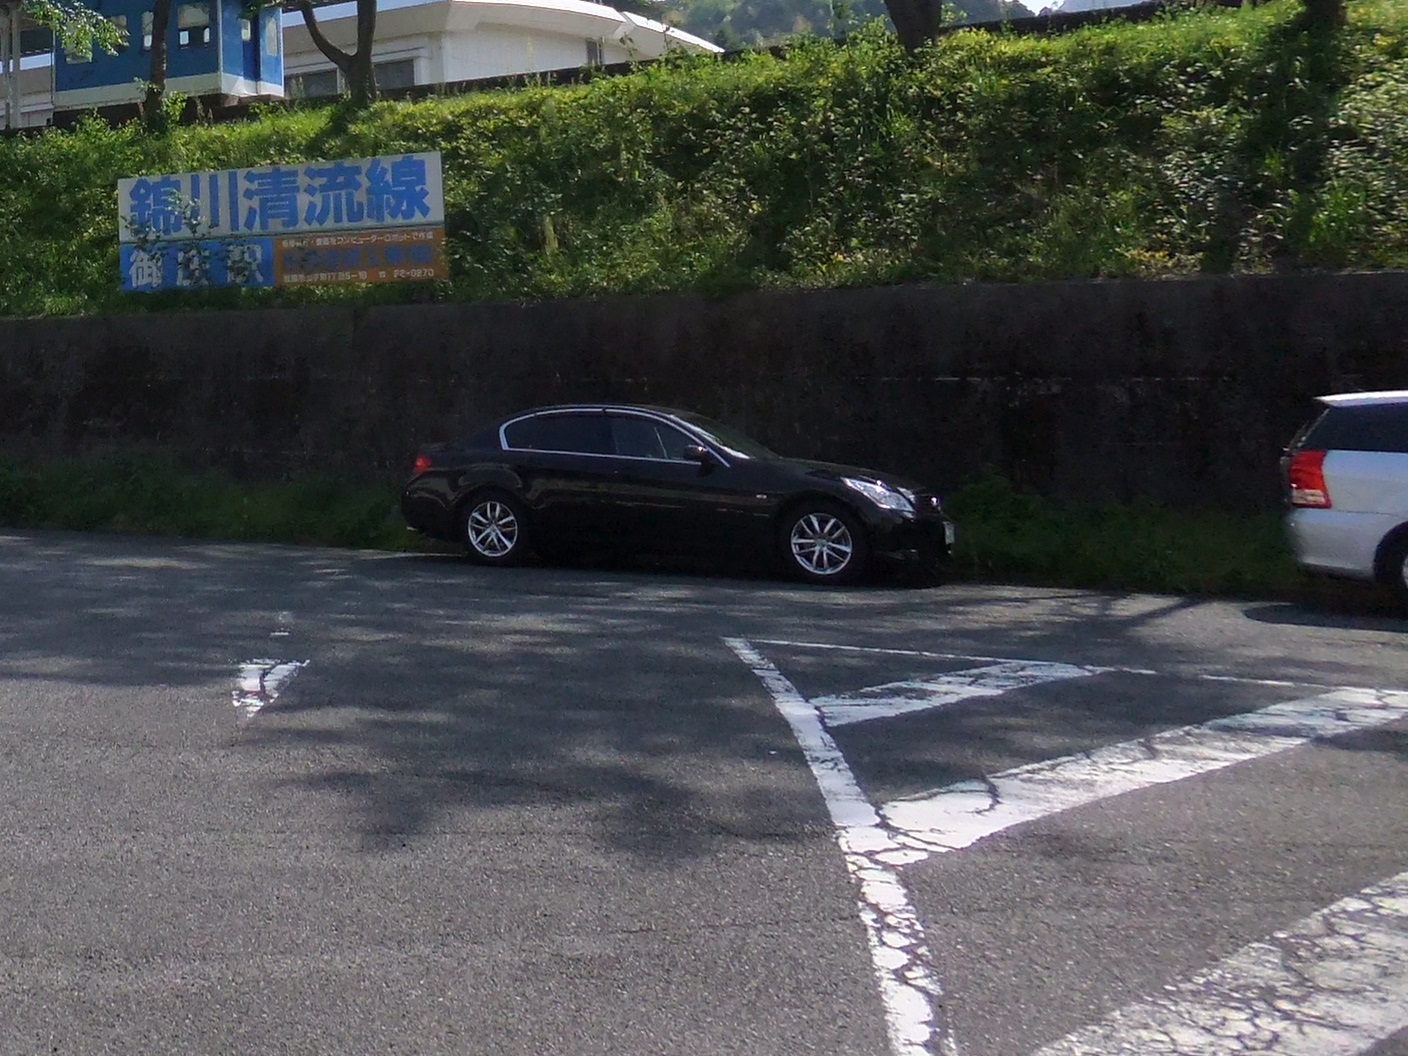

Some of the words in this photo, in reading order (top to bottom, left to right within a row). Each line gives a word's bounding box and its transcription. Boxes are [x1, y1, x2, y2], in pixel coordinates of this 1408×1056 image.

[129, 155, 431, 236] 錦川清流線
